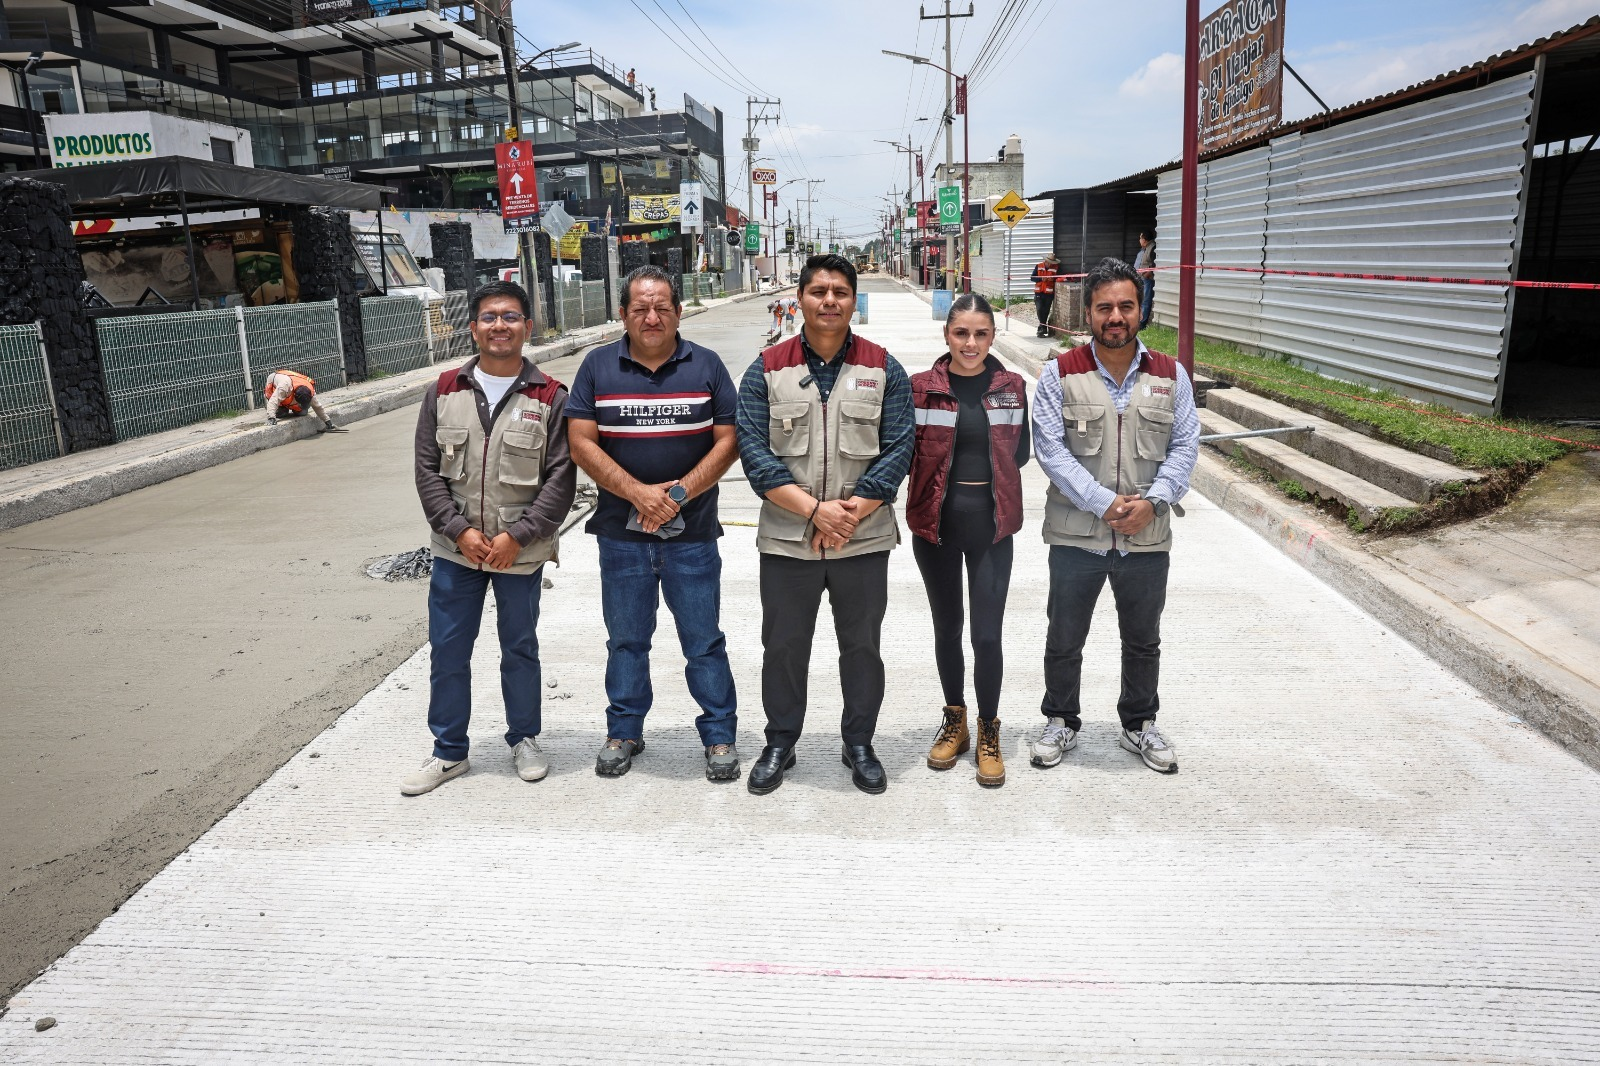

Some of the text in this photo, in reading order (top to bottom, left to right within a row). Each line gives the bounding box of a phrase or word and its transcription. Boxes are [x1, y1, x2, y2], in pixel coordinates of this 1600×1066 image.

[1210, 63, 1223, 104] El
[1211, 77, 1255, 122] de Hidalgo
[53, 132, 152, 157] PRODUCTOS
[755, 172, 776, 181] OXXO
[643, 210, 669, 219] CREPAS
[619, 404, 692, 417] HILFIGER
[636, 418, 655, 426] NEW
